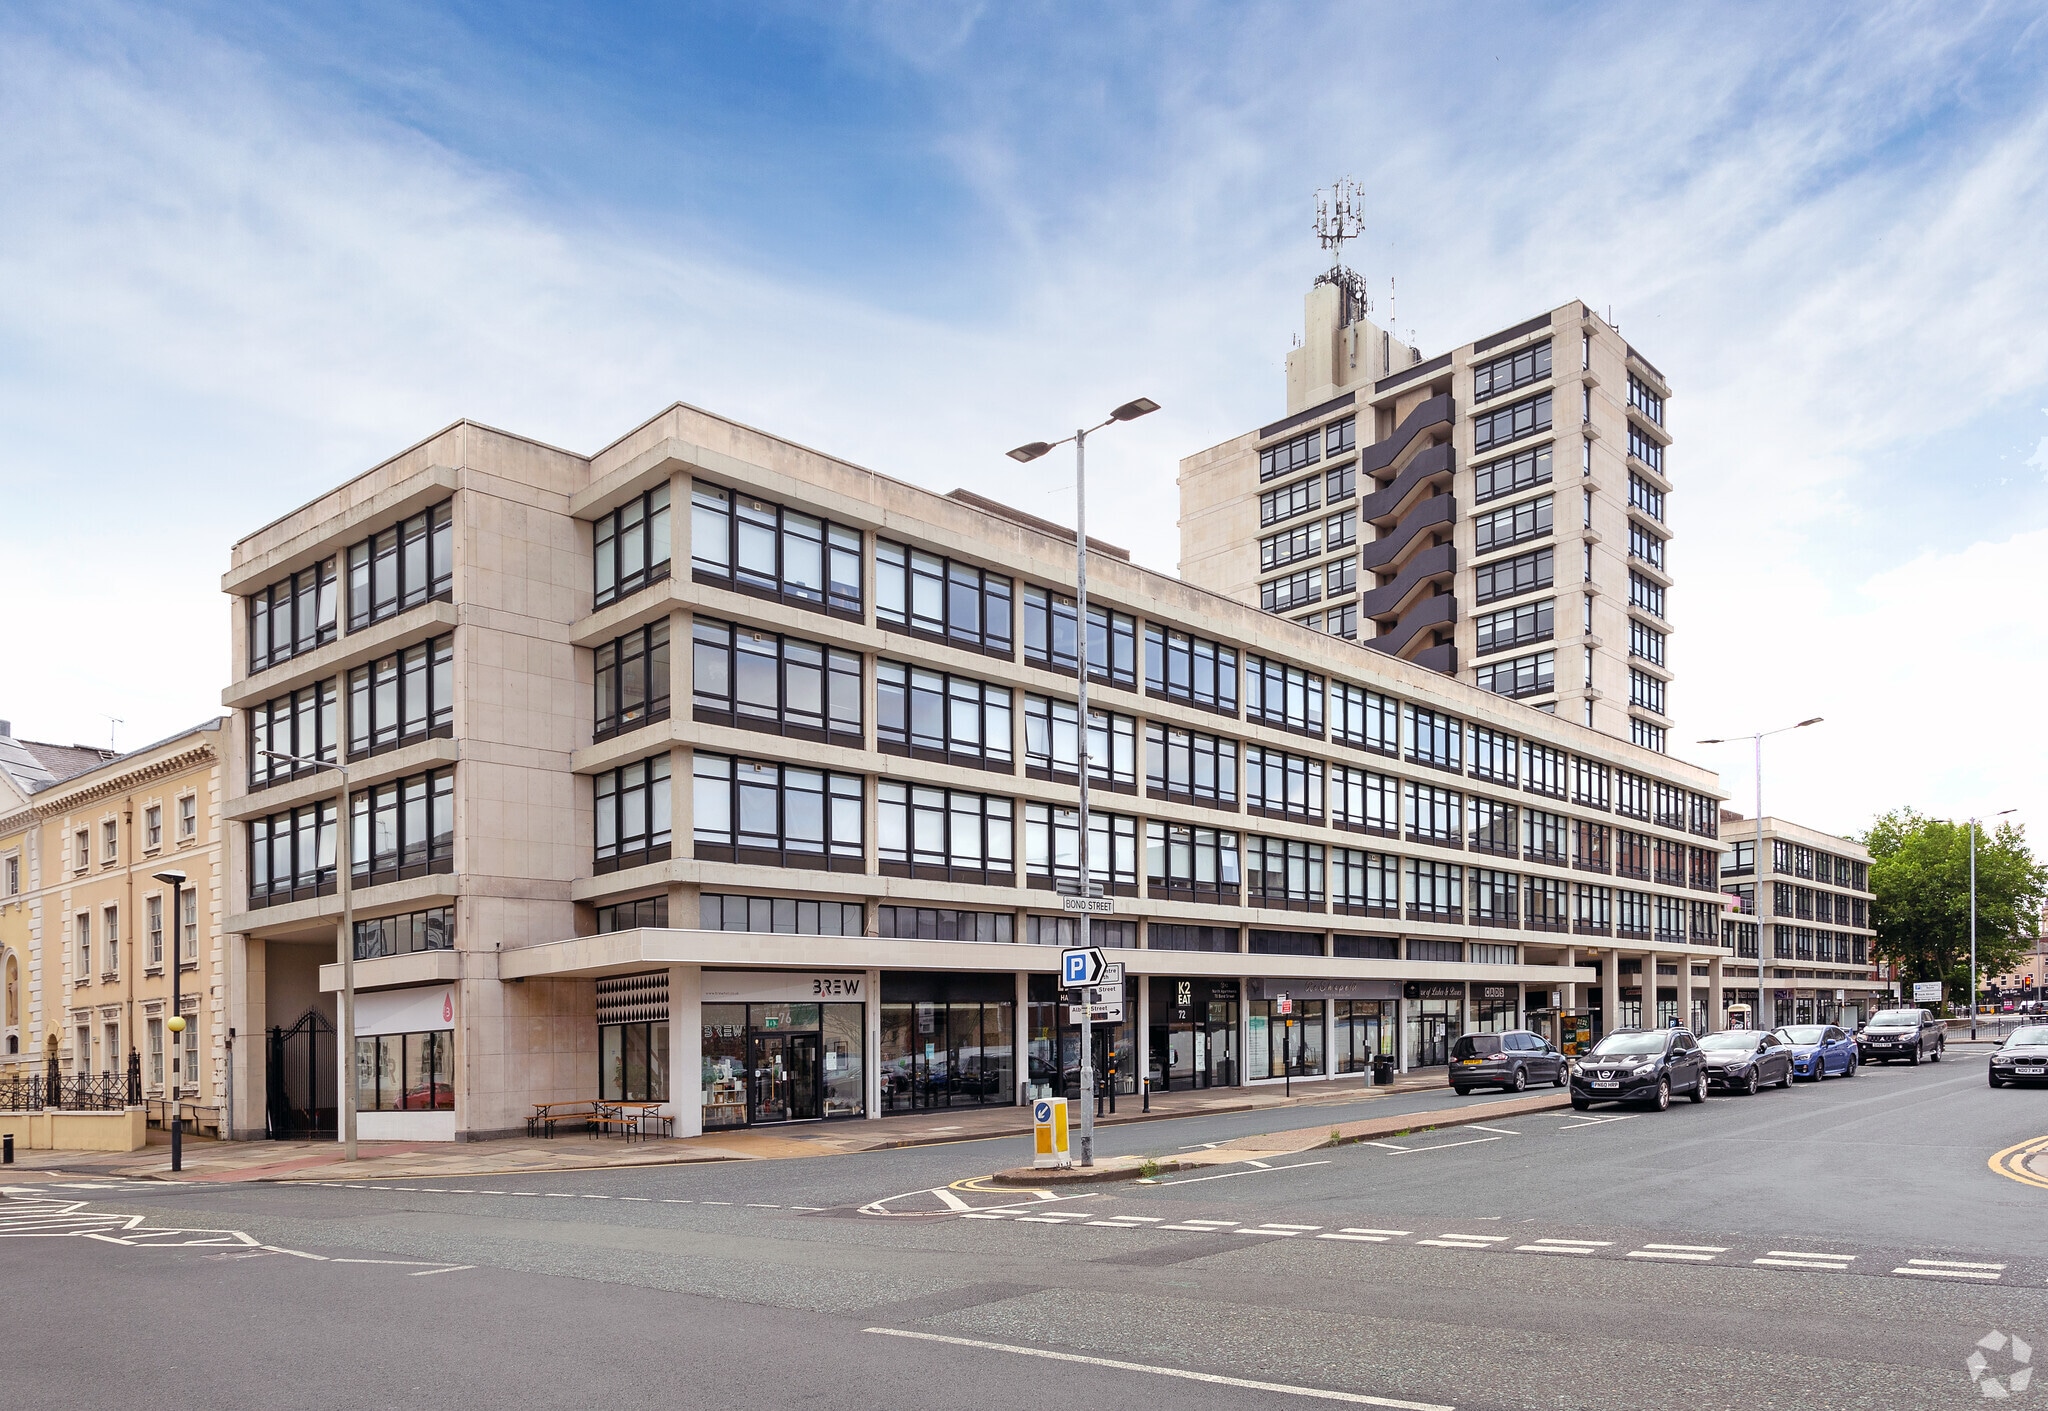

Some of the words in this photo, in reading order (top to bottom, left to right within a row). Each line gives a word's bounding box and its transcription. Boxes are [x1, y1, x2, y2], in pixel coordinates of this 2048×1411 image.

[1066, 899, 1086, 910] BOND
[1088, 901, 1112, 911] STREET
[1070, 957, 1083, 979] P
[813, 979, 860, 996] BREW
[1178, 981, 1191, 994] K2
[1178, 994, 1191, 1005] EAT
[778, 1012, 792, 1024] 76
[1178, 1010, 1186, 1019] 72
[704, 1024, 743, 1038] BREW
